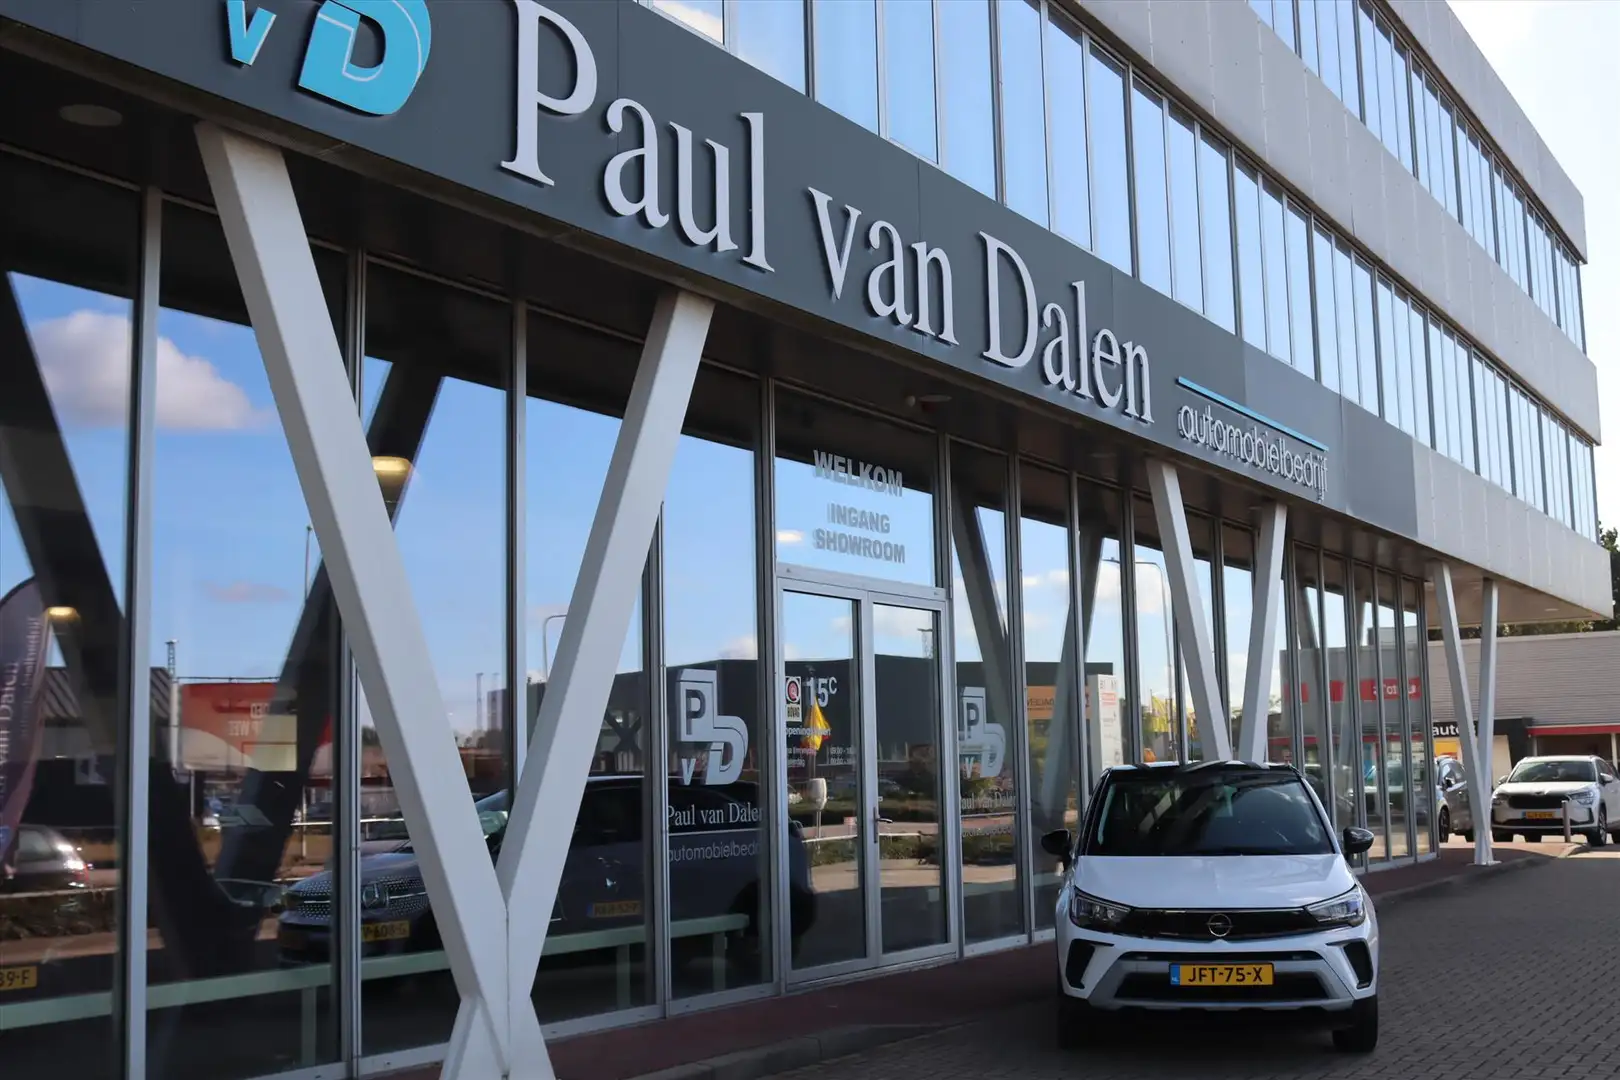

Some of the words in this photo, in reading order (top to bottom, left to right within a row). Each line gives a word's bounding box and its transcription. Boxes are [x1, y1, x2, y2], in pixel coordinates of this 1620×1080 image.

[500, 0, 775, 272] Paul
[808, 187, 959, 346] van
[979, 231, 1154, 423] Dalen
[1178, 405, 1328, 502] automobielbedrijf
[813, 449, 902, 497] WELKOM
[827, 502, 890, 533] INGANG
[812, 528, 905, 564] SHOWROOM
[700, 808, 724, 824] van
[1188, 967, 1263, 983] JFT-75-X
